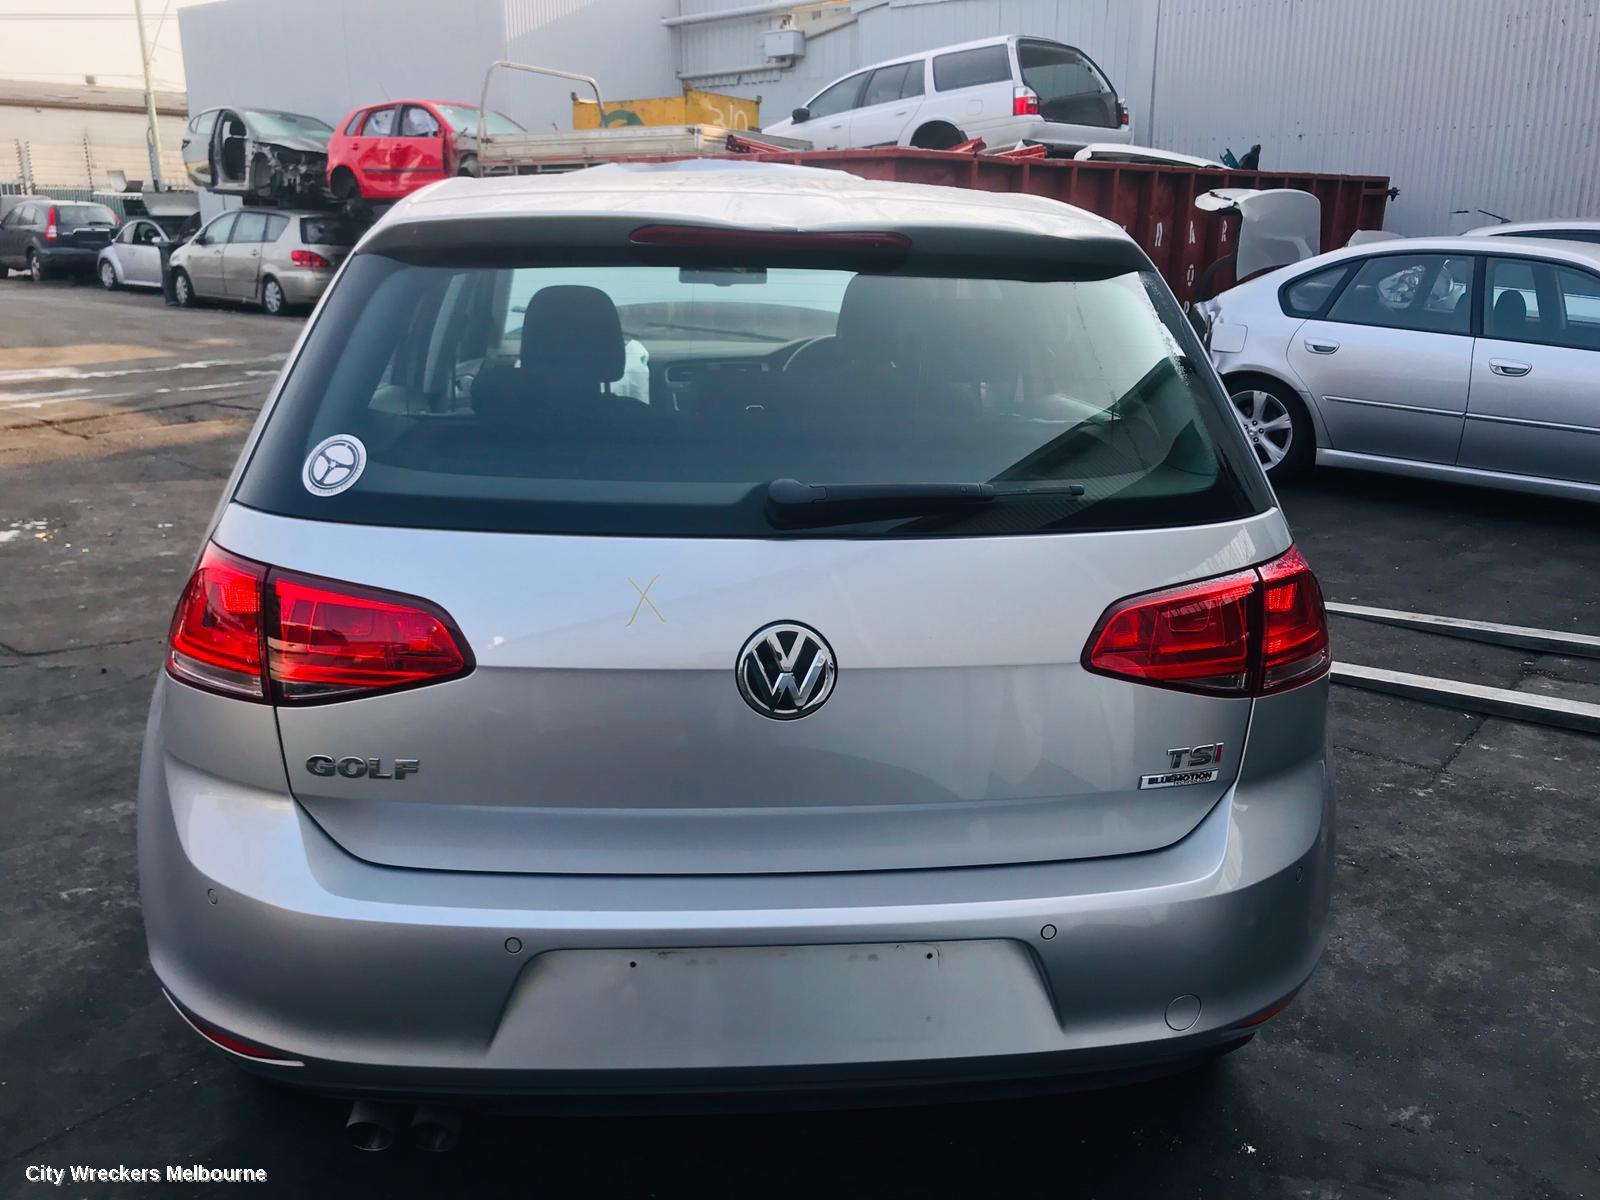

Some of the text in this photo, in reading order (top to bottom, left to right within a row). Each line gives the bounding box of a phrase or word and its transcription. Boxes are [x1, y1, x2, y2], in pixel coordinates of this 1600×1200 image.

[306, 754, 421, 781] GOLF
[1166, 742, 1224, 769] TSI
[1147, 771, 1213, 784] BLUEMOTION
